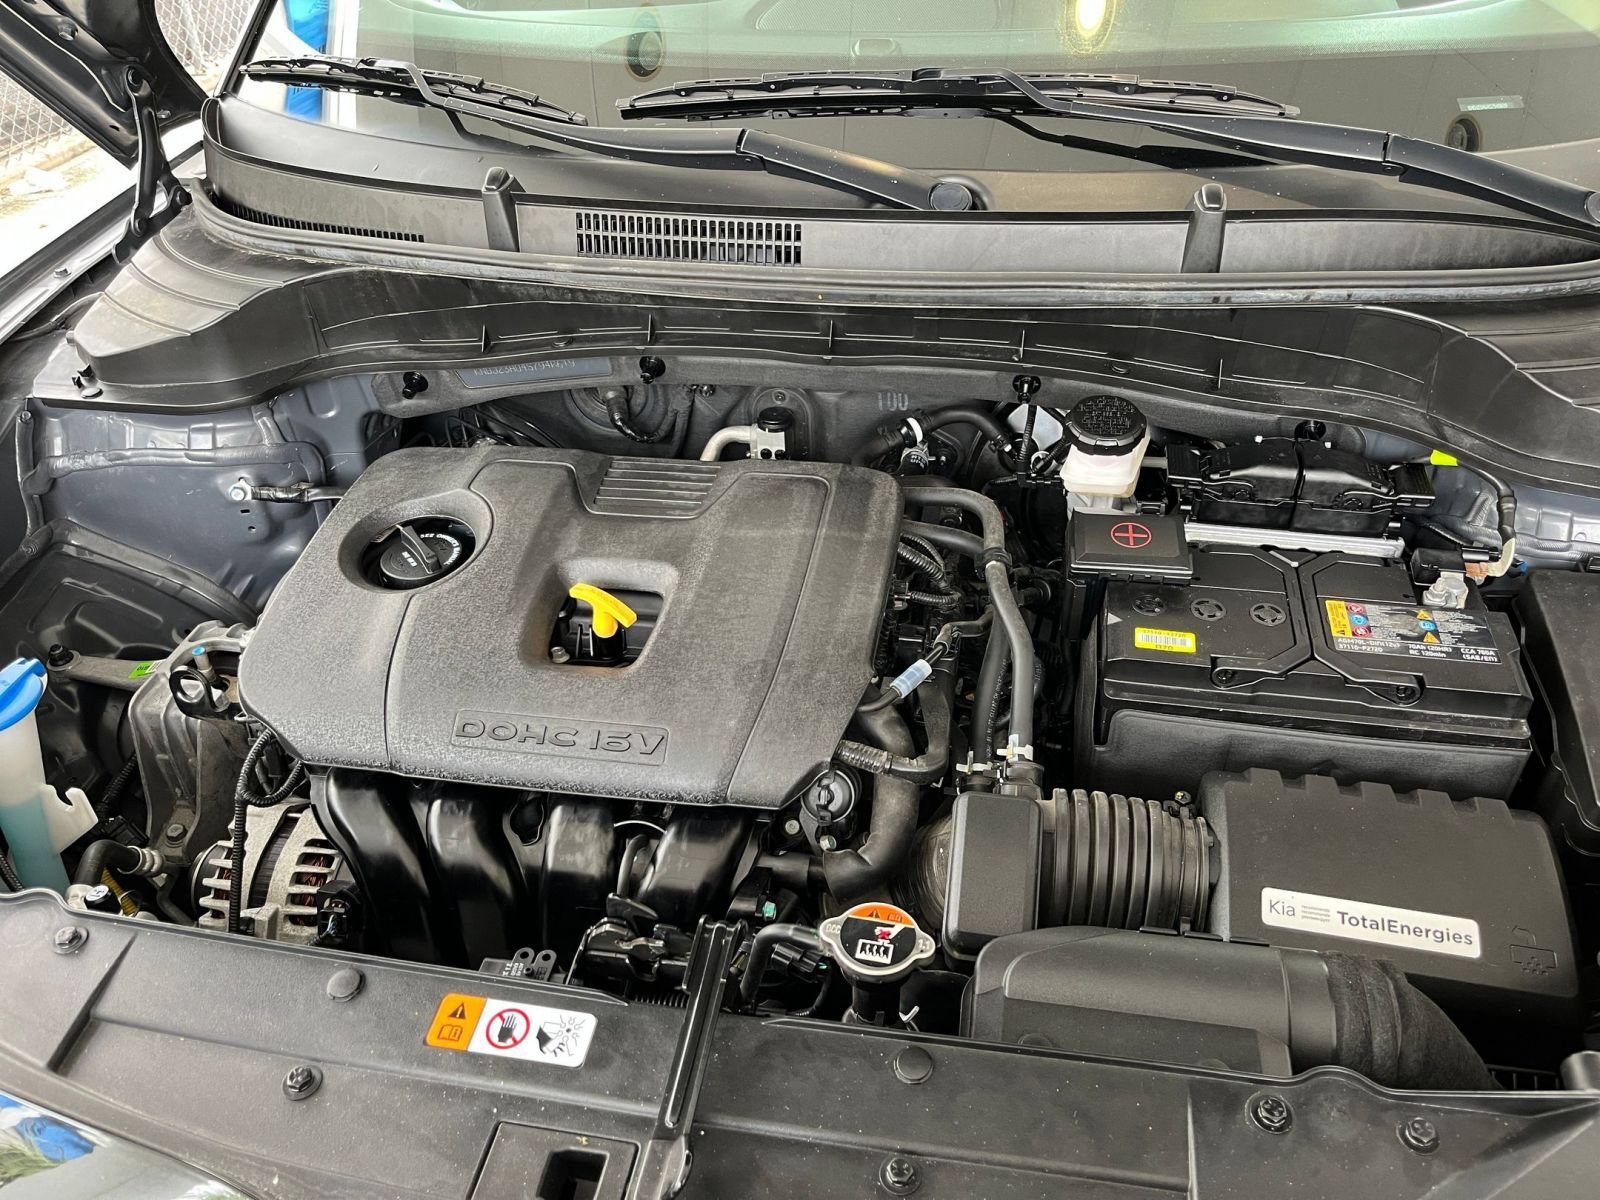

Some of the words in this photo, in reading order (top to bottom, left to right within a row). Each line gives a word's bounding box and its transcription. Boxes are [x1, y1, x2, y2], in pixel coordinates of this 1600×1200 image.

[455, 719, 580, 747] DOHC
[589, 728, 665, 755] 16V
[1268, 899, 1296, 918] Kia
[1337, 910, 1474, 945] TotalEnergies
